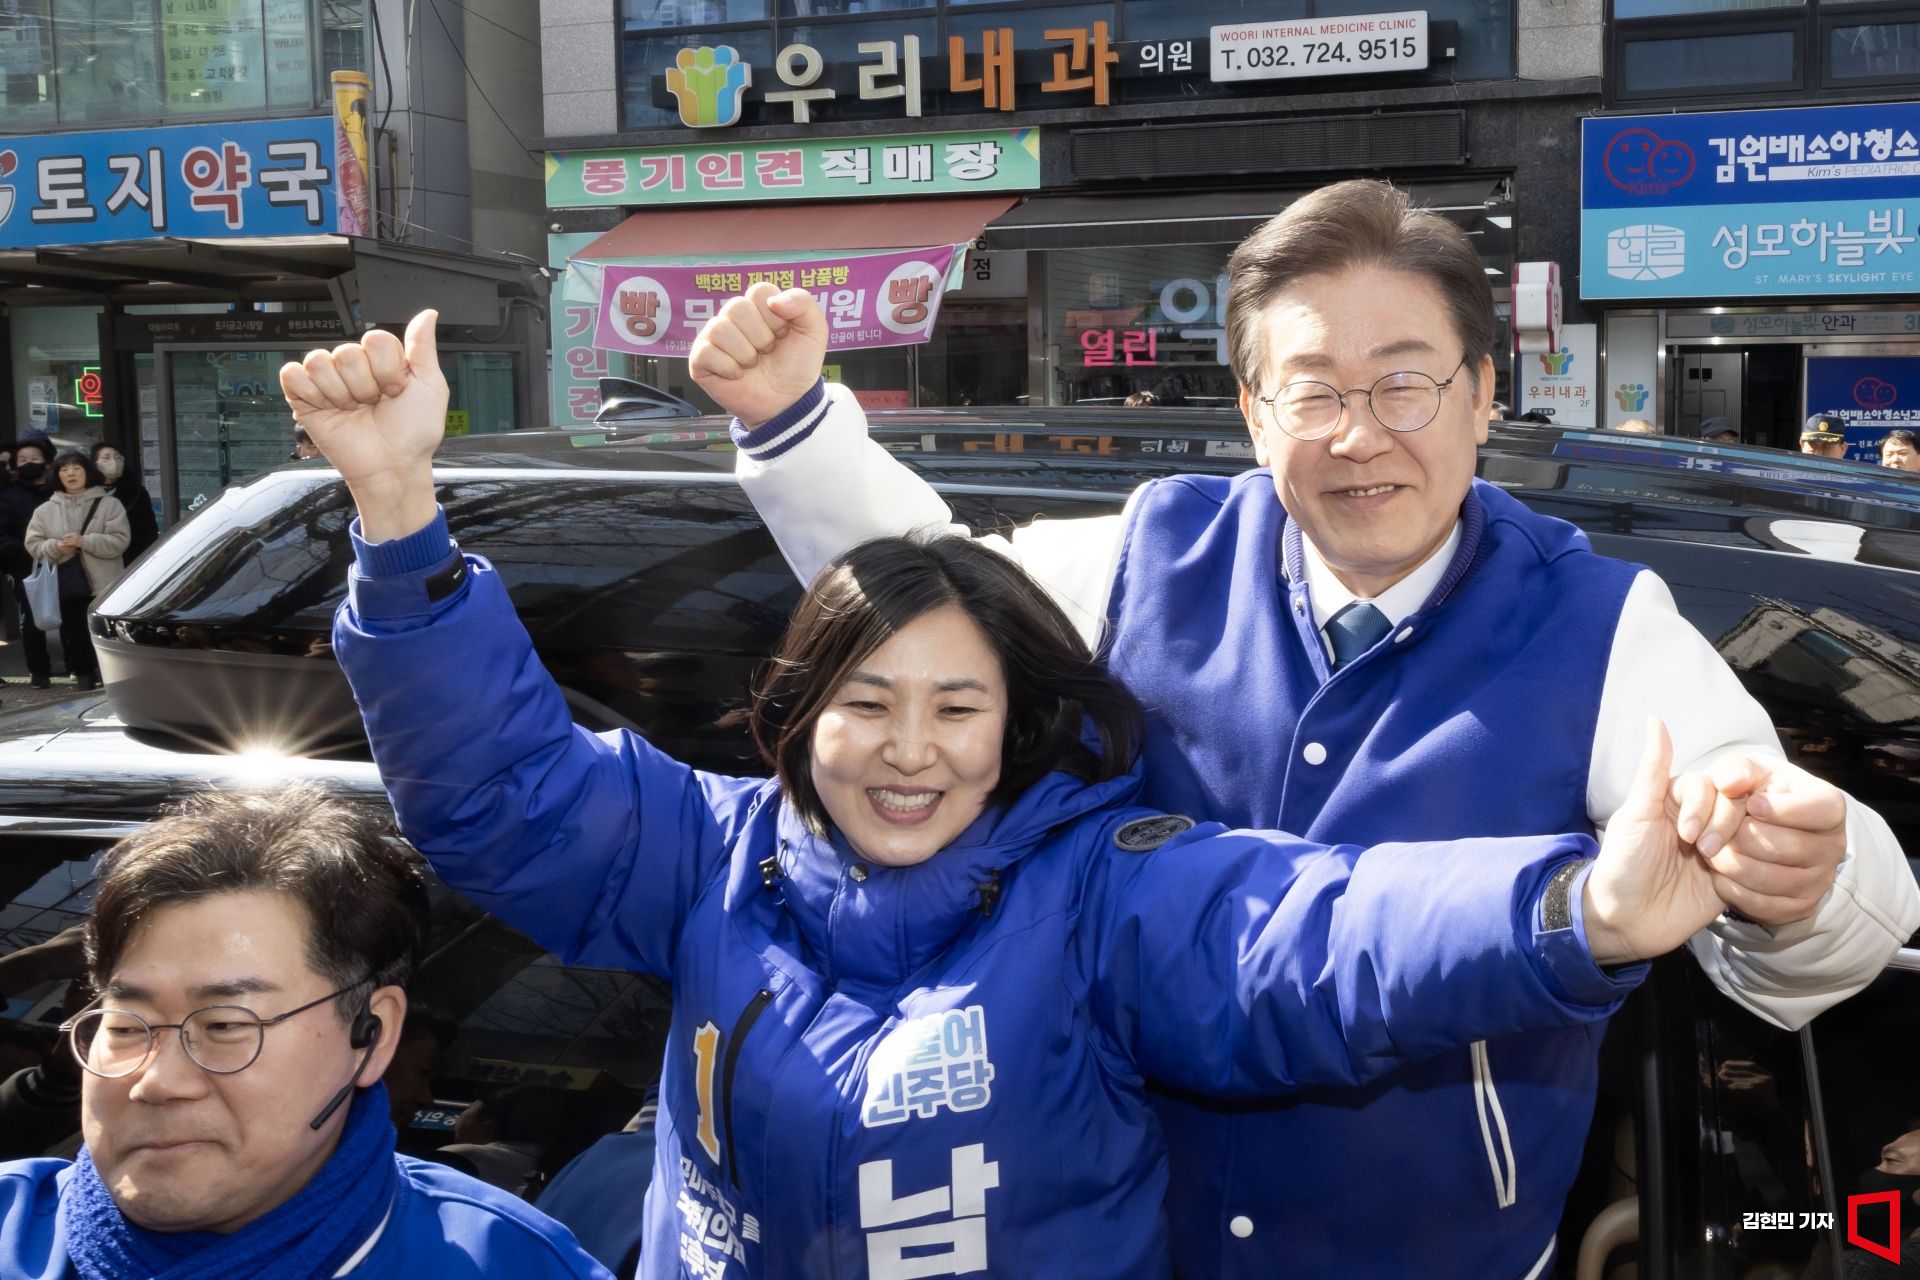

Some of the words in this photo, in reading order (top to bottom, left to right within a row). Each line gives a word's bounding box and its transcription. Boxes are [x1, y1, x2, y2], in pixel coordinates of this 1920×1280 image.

[1220, 31, 1258, 42] WOORI
[1262, 26, 1315, 40] INTERNAL
[1320, 21, 1375, 35] MEDICINE
[1379, 18, 1417, 31] CLINIC
[1140, 41, 1192, 72] 의원
[581, 151, 804, 195] 풍기인견
[820, 140, 1002, 184] 직매장
[1807, 164, 1841, 178] Kim's
[1845, 163, 1910, 176] PEDIATRIC
[31, 139, 331, 231] 토지약국
[1711, 208, 1915, 270] 성모하늘빛
[695, 273, 742, 292] 백화점
[800, 266, 849, 288] 납품빵
[1755, 275, 1773, 285] ST.
[1778, 273, 1823, 284] MARY'S
[1828, 272, 1886, 283] SKYLIGHT
[1891, 271, 1914, 281] EYE
[620, 291, 660, 337] 빵
[888, 274, 933, 325] 빵
[831, 331, 854, 343] 단골이
[857, 328, 882, 341] 됩니다
[1080, 329, 1158, 366] 열린
[1528, 385, 1587, 399] 우리내과
[1579, 399, 1591, 407] 2F
[693, 1018, 720, 1166] 1
[859, 1143, 999, 1280] 남
